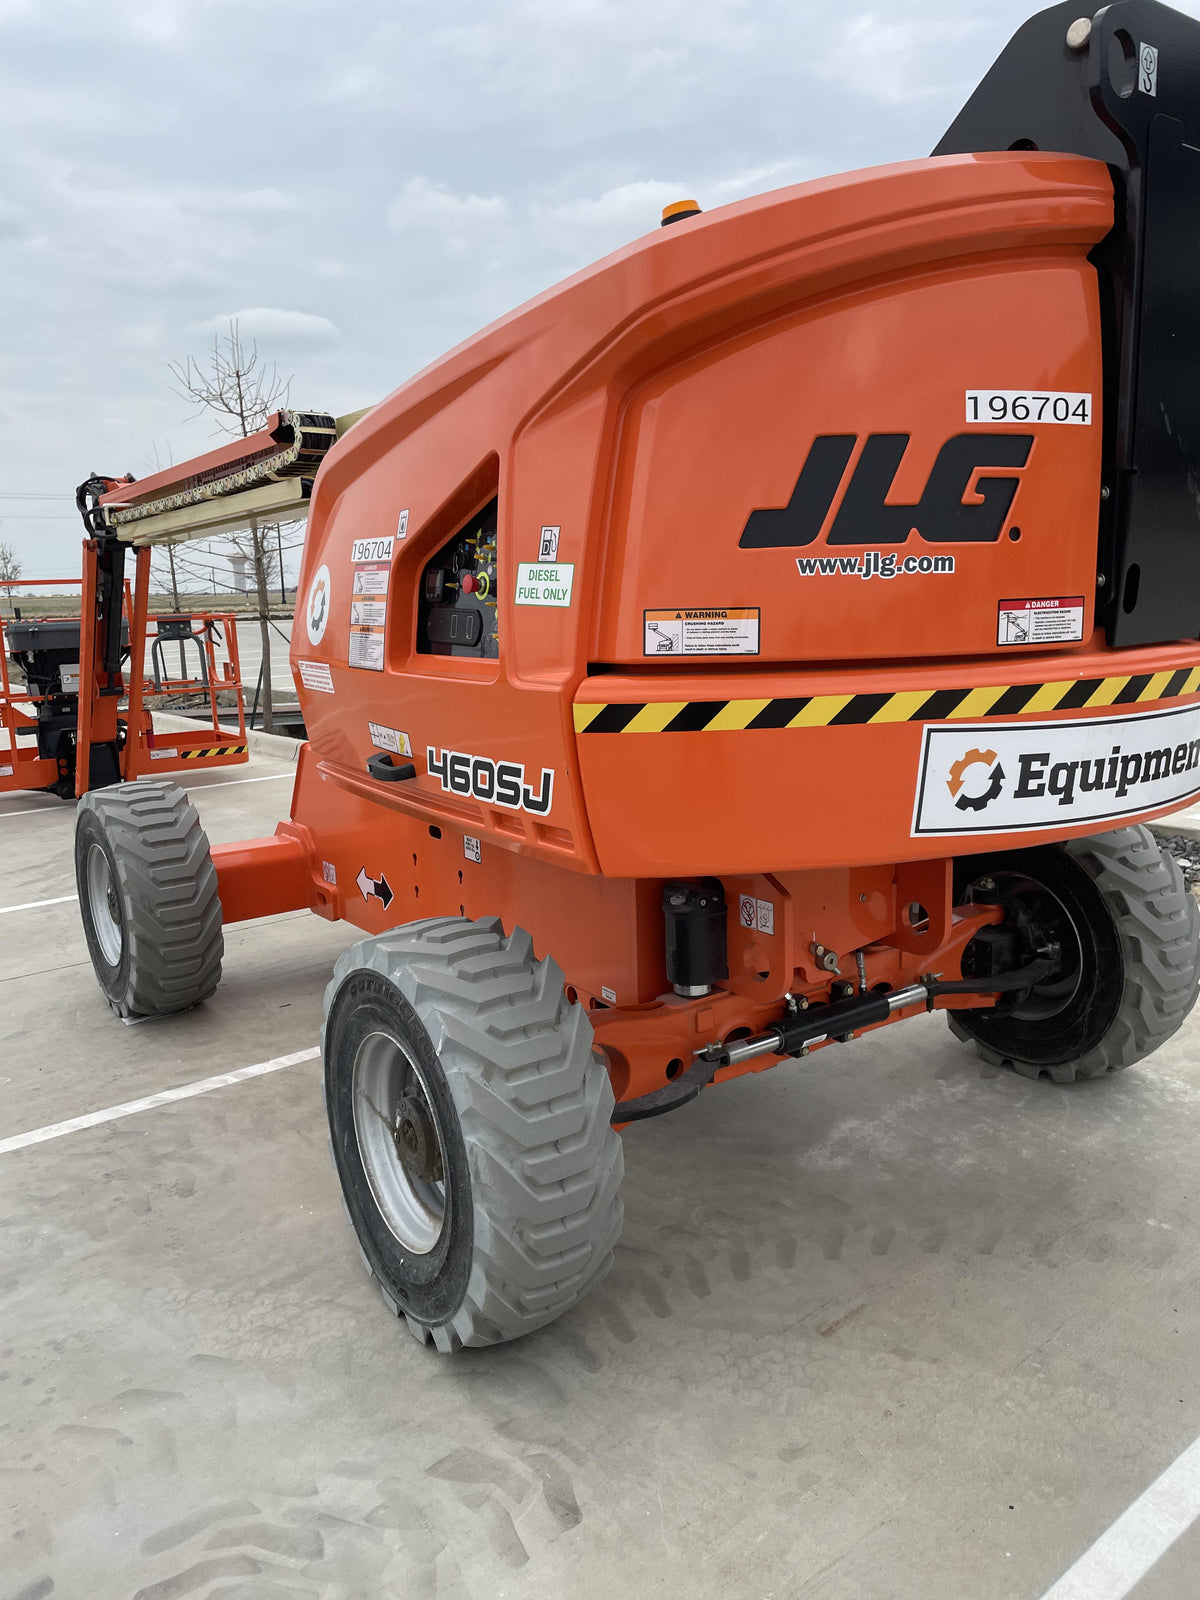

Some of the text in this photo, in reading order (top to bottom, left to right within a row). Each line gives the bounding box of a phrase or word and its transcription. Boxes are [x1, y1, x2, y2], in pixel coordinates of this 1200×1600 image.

[968, 396, 1089, 422] 196704
[738, 434, 1035, 549] JLG
[352, 540, 392, 560] 196704
[797, 552, 954, 578] www.jlg.com
[528, 569, 560, 582] DIESEL
[518, 587, 568, 600] FUEL ONLY
[1031, 600, 1059, 608] DANGER
[684, 611, 728, 619] WARNING
[427, 748, 553, 815] 460SJ
